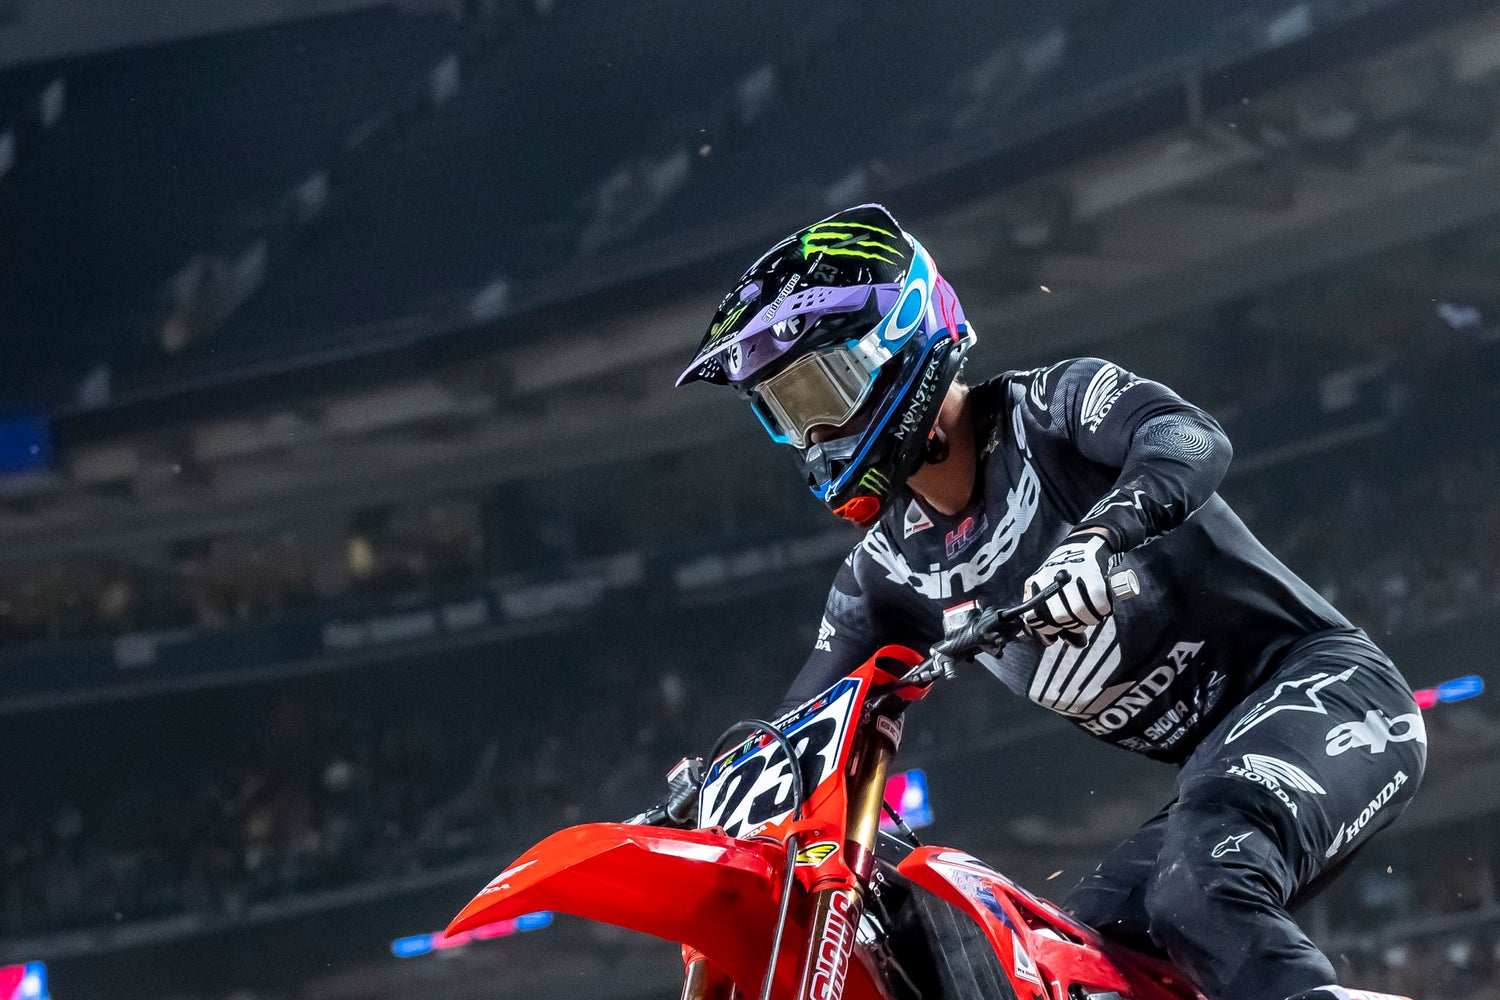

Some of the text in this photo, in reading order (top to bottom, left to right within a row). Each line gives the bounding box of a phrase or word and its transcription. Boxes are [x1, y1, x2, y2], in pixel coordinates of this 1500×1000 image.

[894, 358, 940, 441] MONSTER
[1079, 641, 1206, 736] HONDA
[1226, 765, 1299, 819] HONDA
[1346, 770, 1409, 833] HONDA
